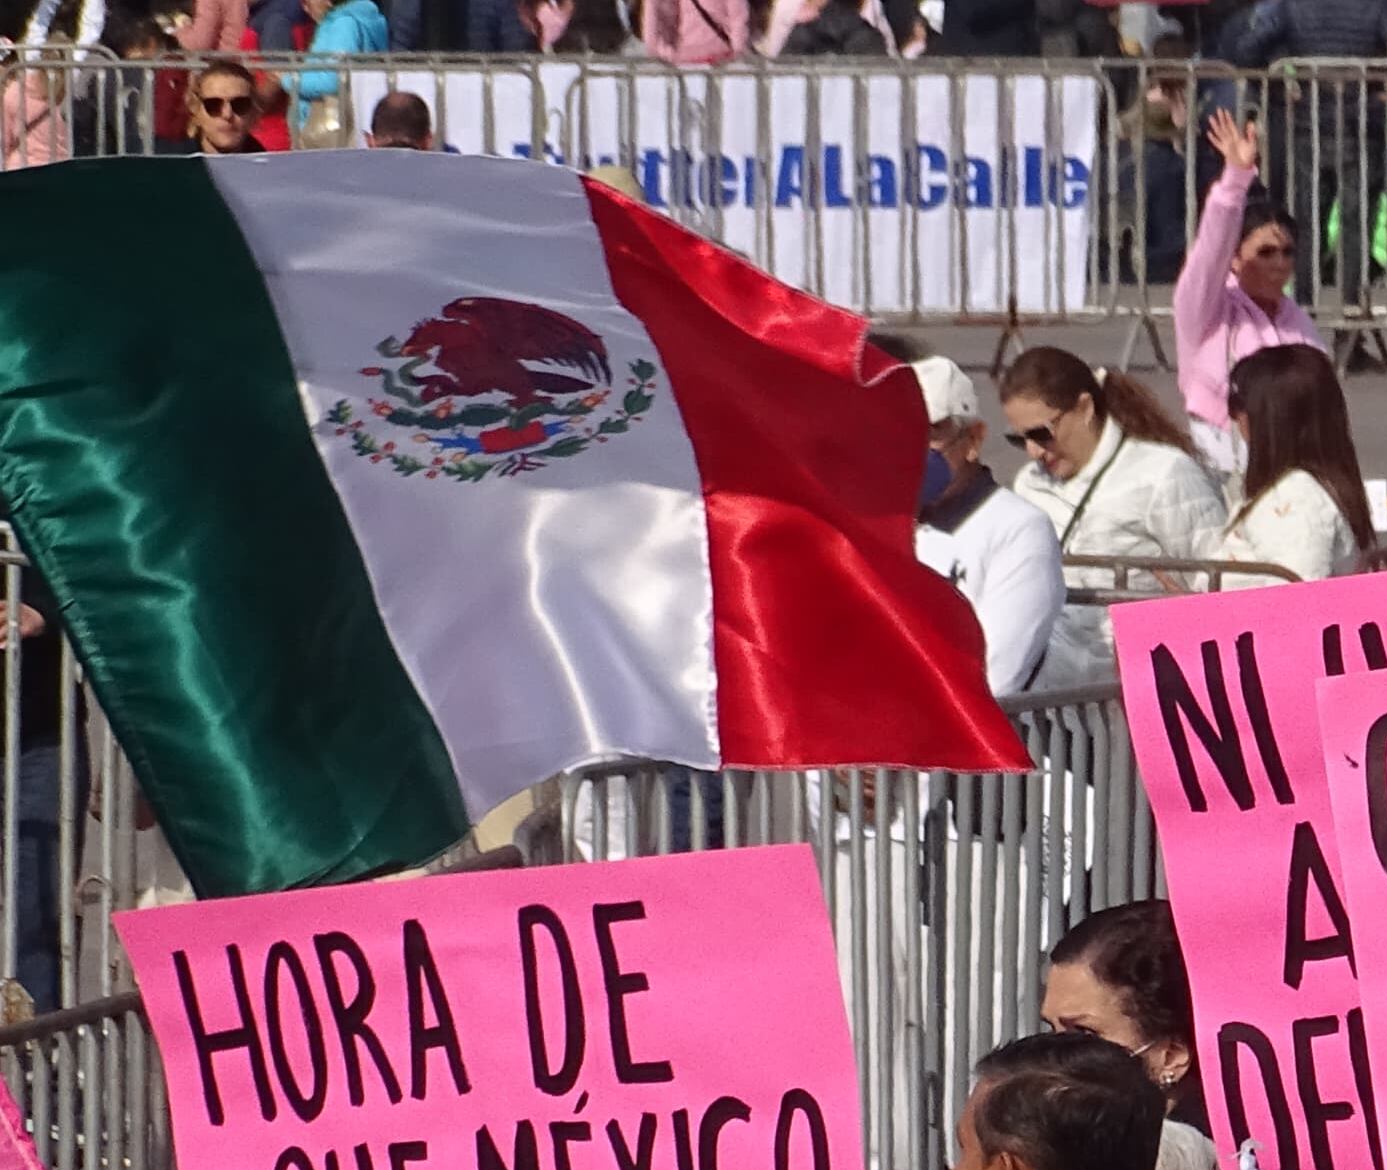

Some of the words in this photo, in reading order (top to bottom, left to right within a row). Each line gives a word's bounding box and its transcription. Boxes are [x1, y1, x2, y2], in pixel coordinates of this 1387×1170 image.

[1150, 633, 1293, 811] NI
[173, 920, 469, 1125] HORA
[519, 902, 673, 1095] DE
